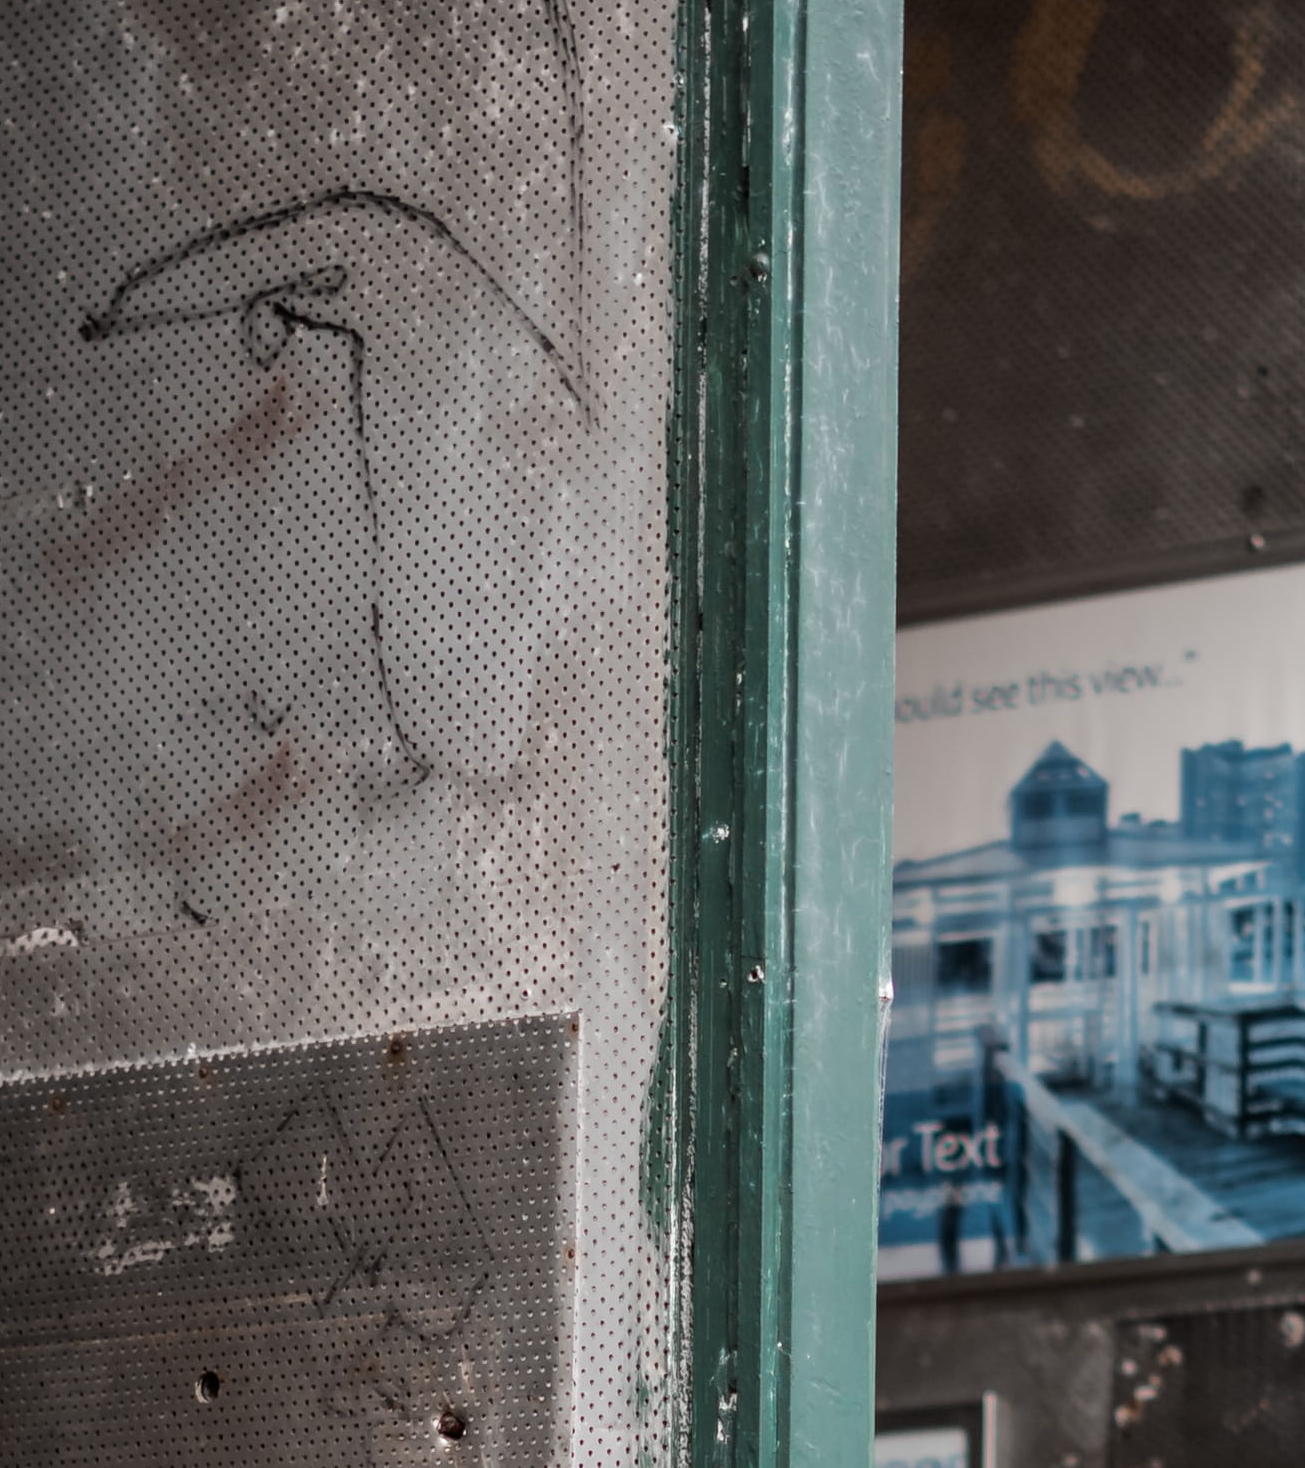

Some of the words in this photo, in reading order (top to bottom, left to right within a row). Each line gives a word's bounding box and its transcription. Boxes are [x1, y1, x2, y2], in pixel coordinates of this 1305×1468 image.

[971, 682, 1020, 714] see
[1027, 668, 1082, 706] this
[913, 1120, 1001, 1173] Text
